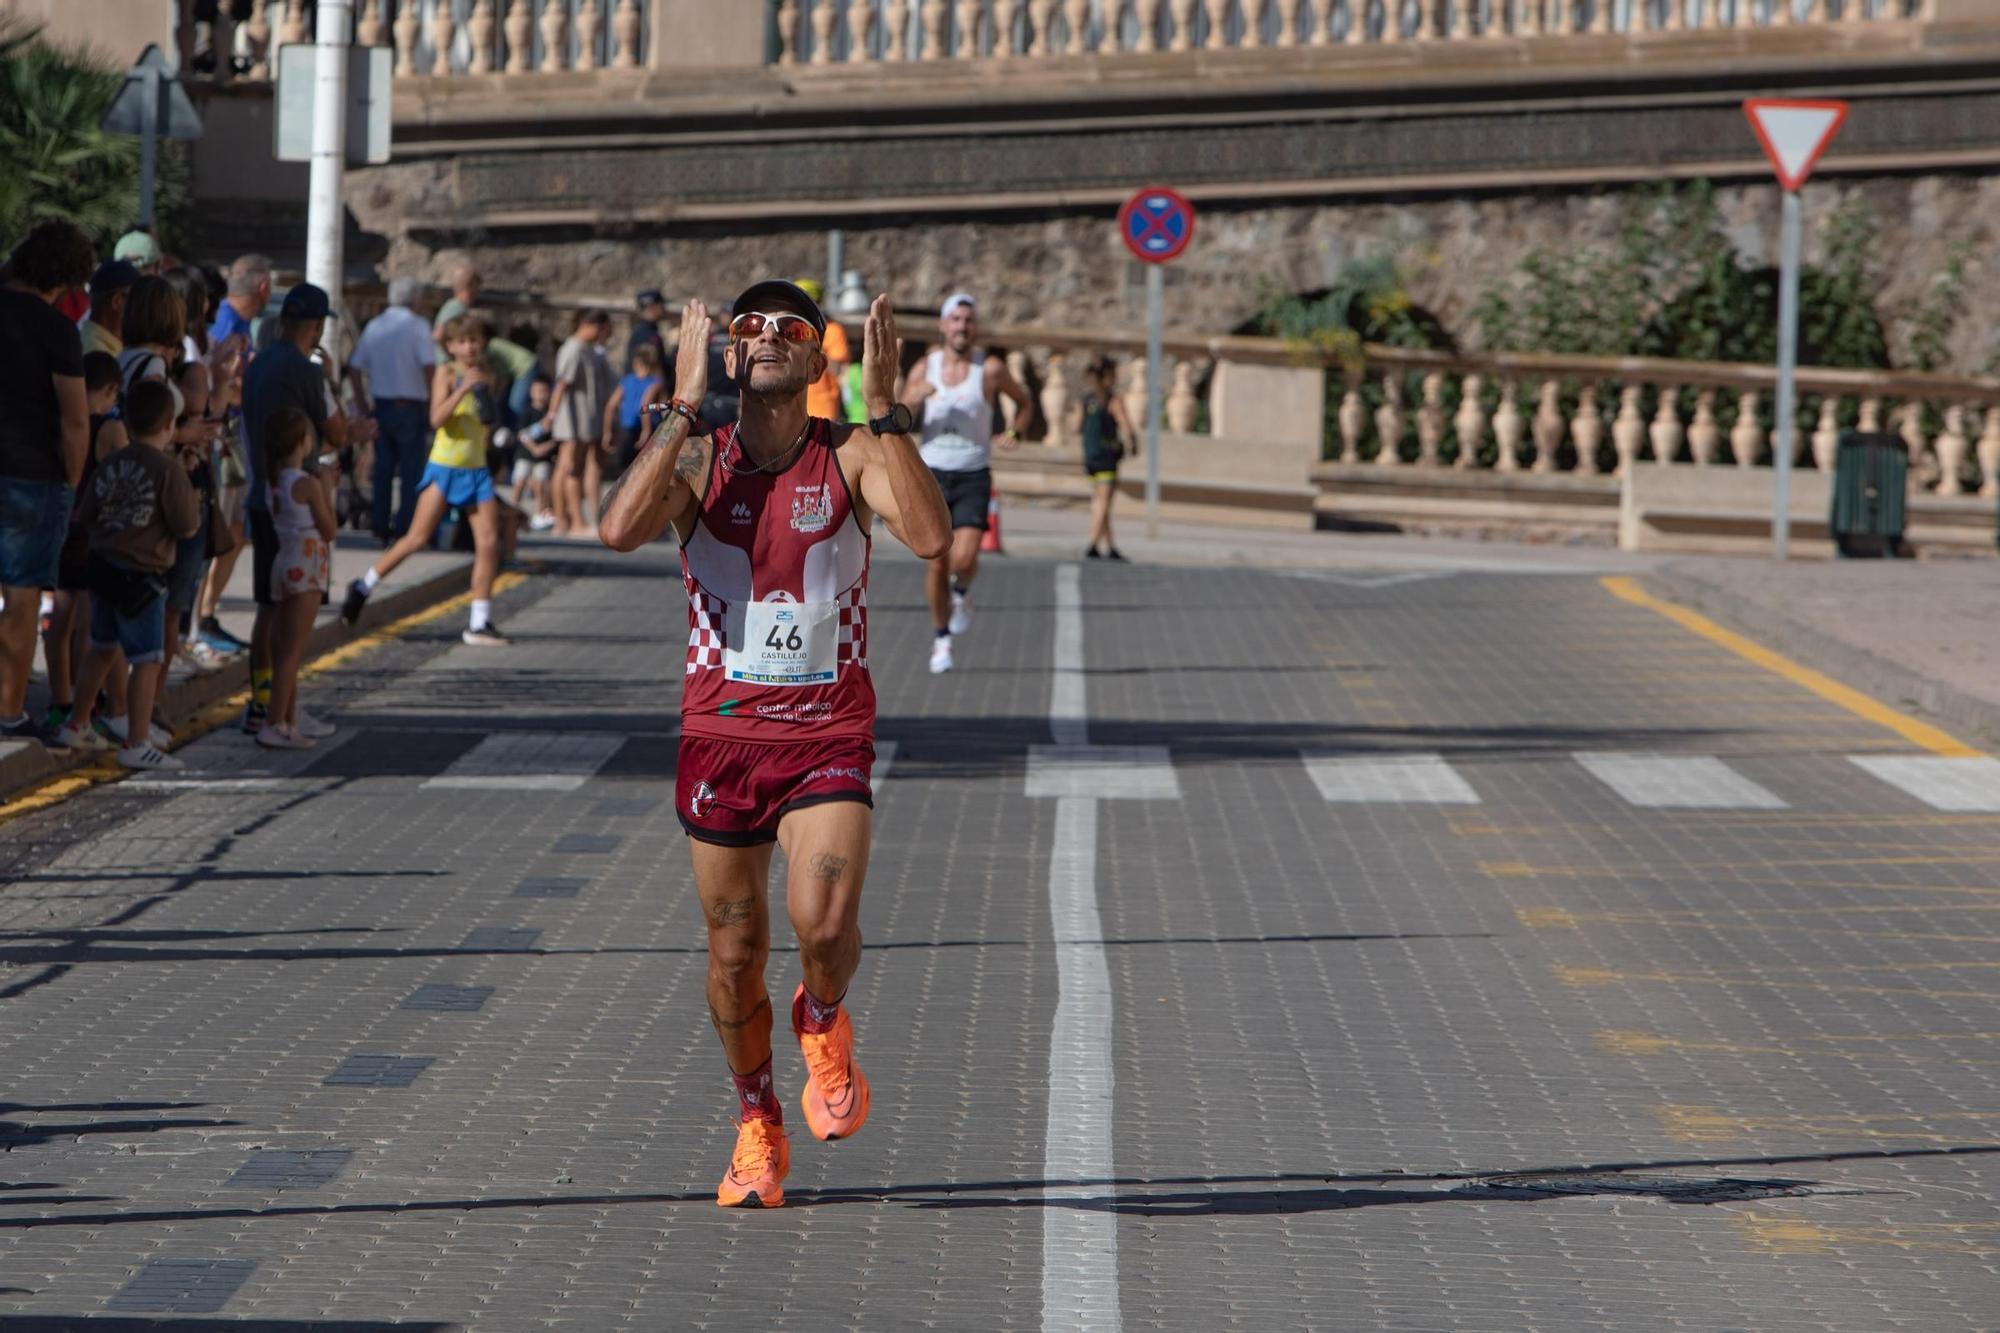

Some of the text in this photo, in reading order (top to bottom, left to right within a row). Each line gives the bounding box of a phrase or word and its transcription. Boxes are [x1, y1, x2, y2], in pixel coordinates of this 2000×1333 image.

[765, 624, 803, 651] 46
[761, 652, 807, 660] CASTILLEJO
[756, 703, 790, 713] centro
[781, 712, 794, 720] de
[804, 710, 832, 720] caridad
